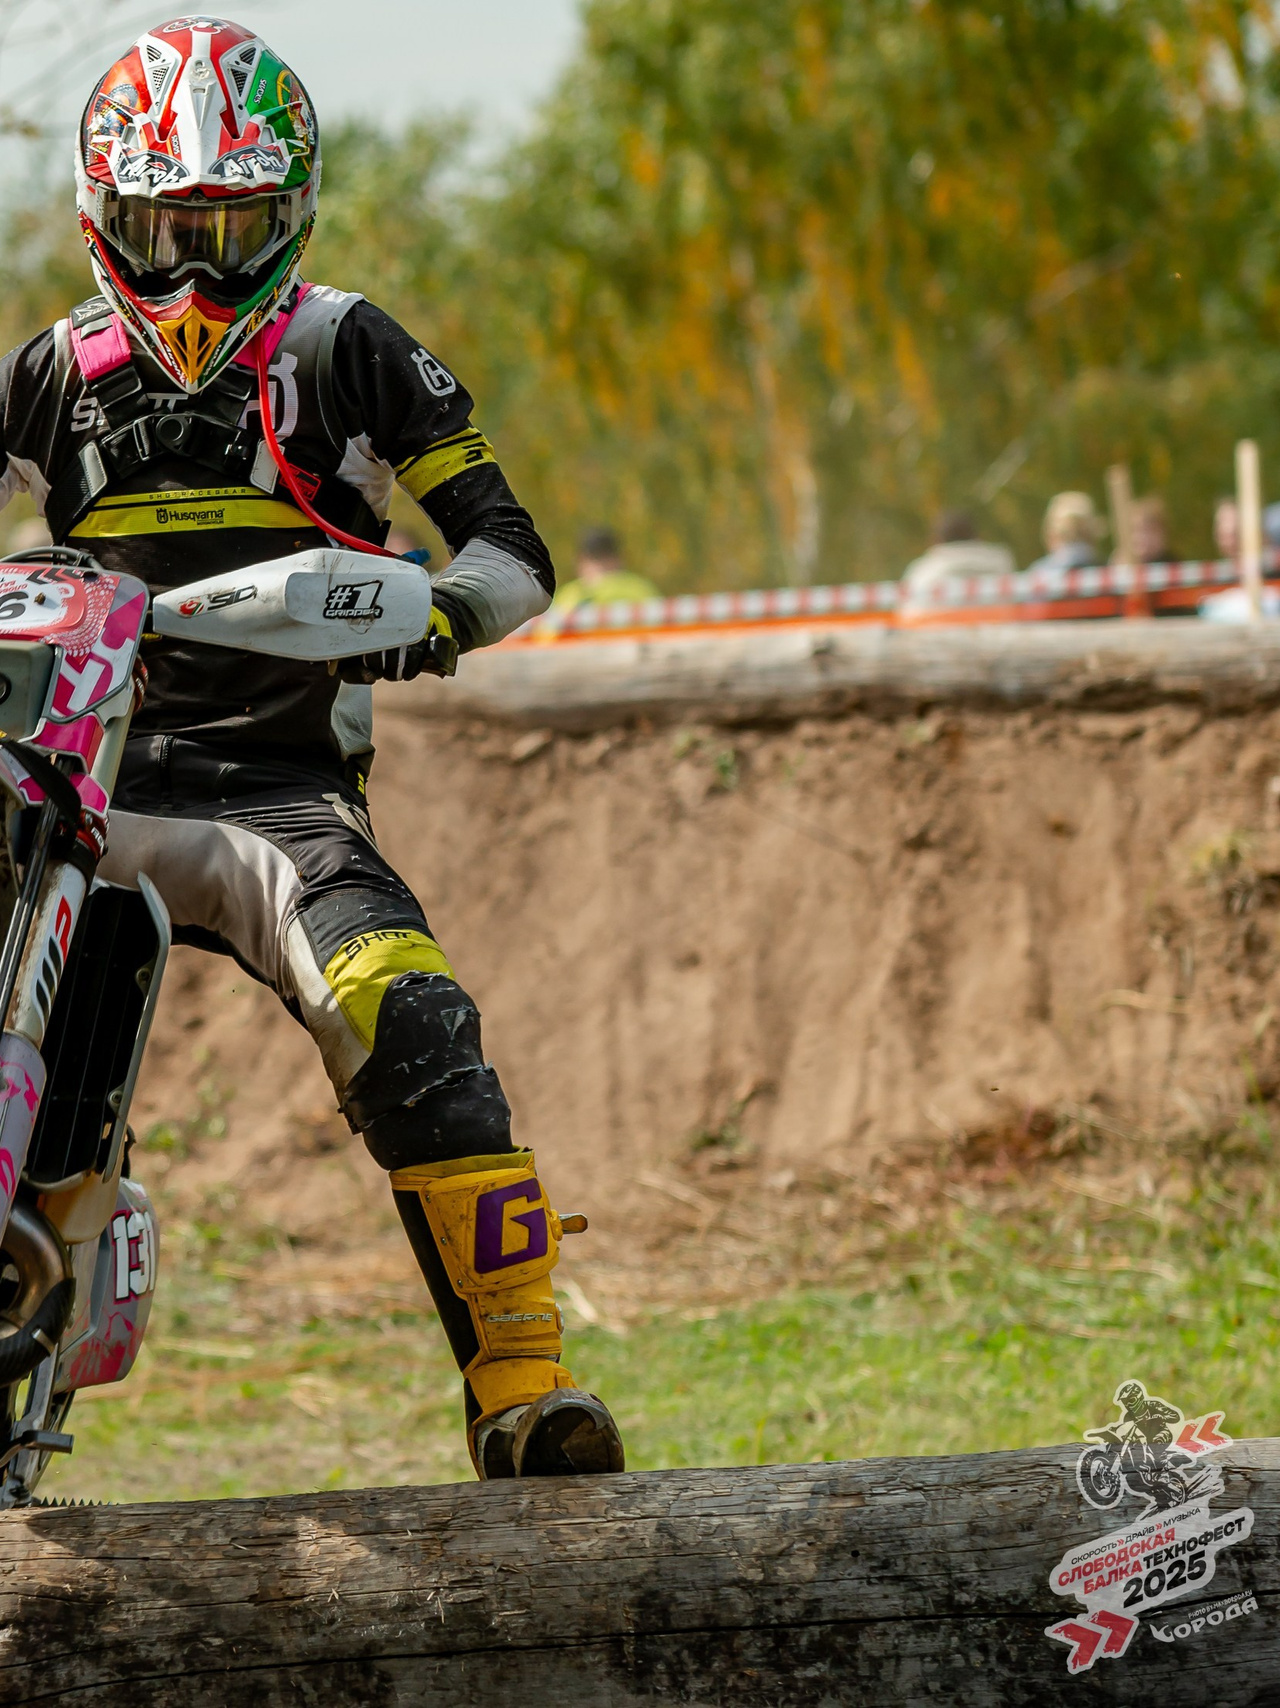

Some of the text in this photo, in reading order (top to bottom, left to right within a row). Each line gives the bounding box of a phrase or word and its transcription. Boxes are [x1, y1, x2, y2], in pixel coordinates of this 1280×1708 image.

[119, 155, 180, 183] Airoh
[223, 149, 283, 177] Airoh
[169, 509, 224, 521] Husqvarna
[345, 931, 411, 961] SHOT
[474, 1178, 548, 1274] G
